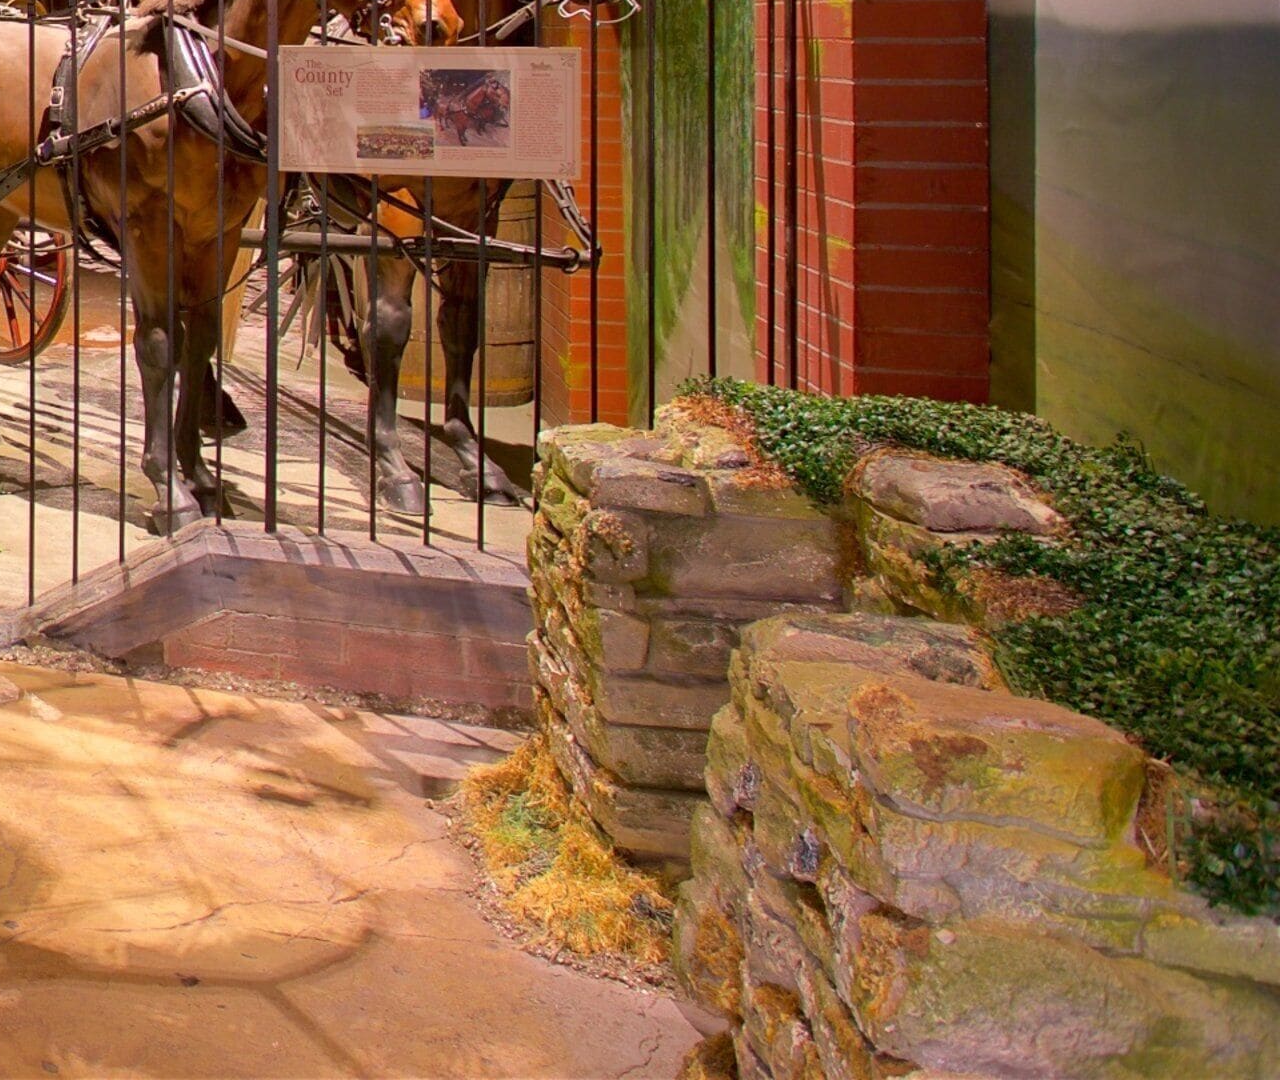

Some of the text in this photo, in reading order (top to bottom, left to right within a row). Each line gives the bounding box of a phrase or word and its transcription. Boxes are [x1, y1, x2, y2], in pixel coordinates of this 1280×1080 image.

[305, 59, 322, 68] The
[295, 67, 353, 88] County
[326, 85, 343, 97] Set
